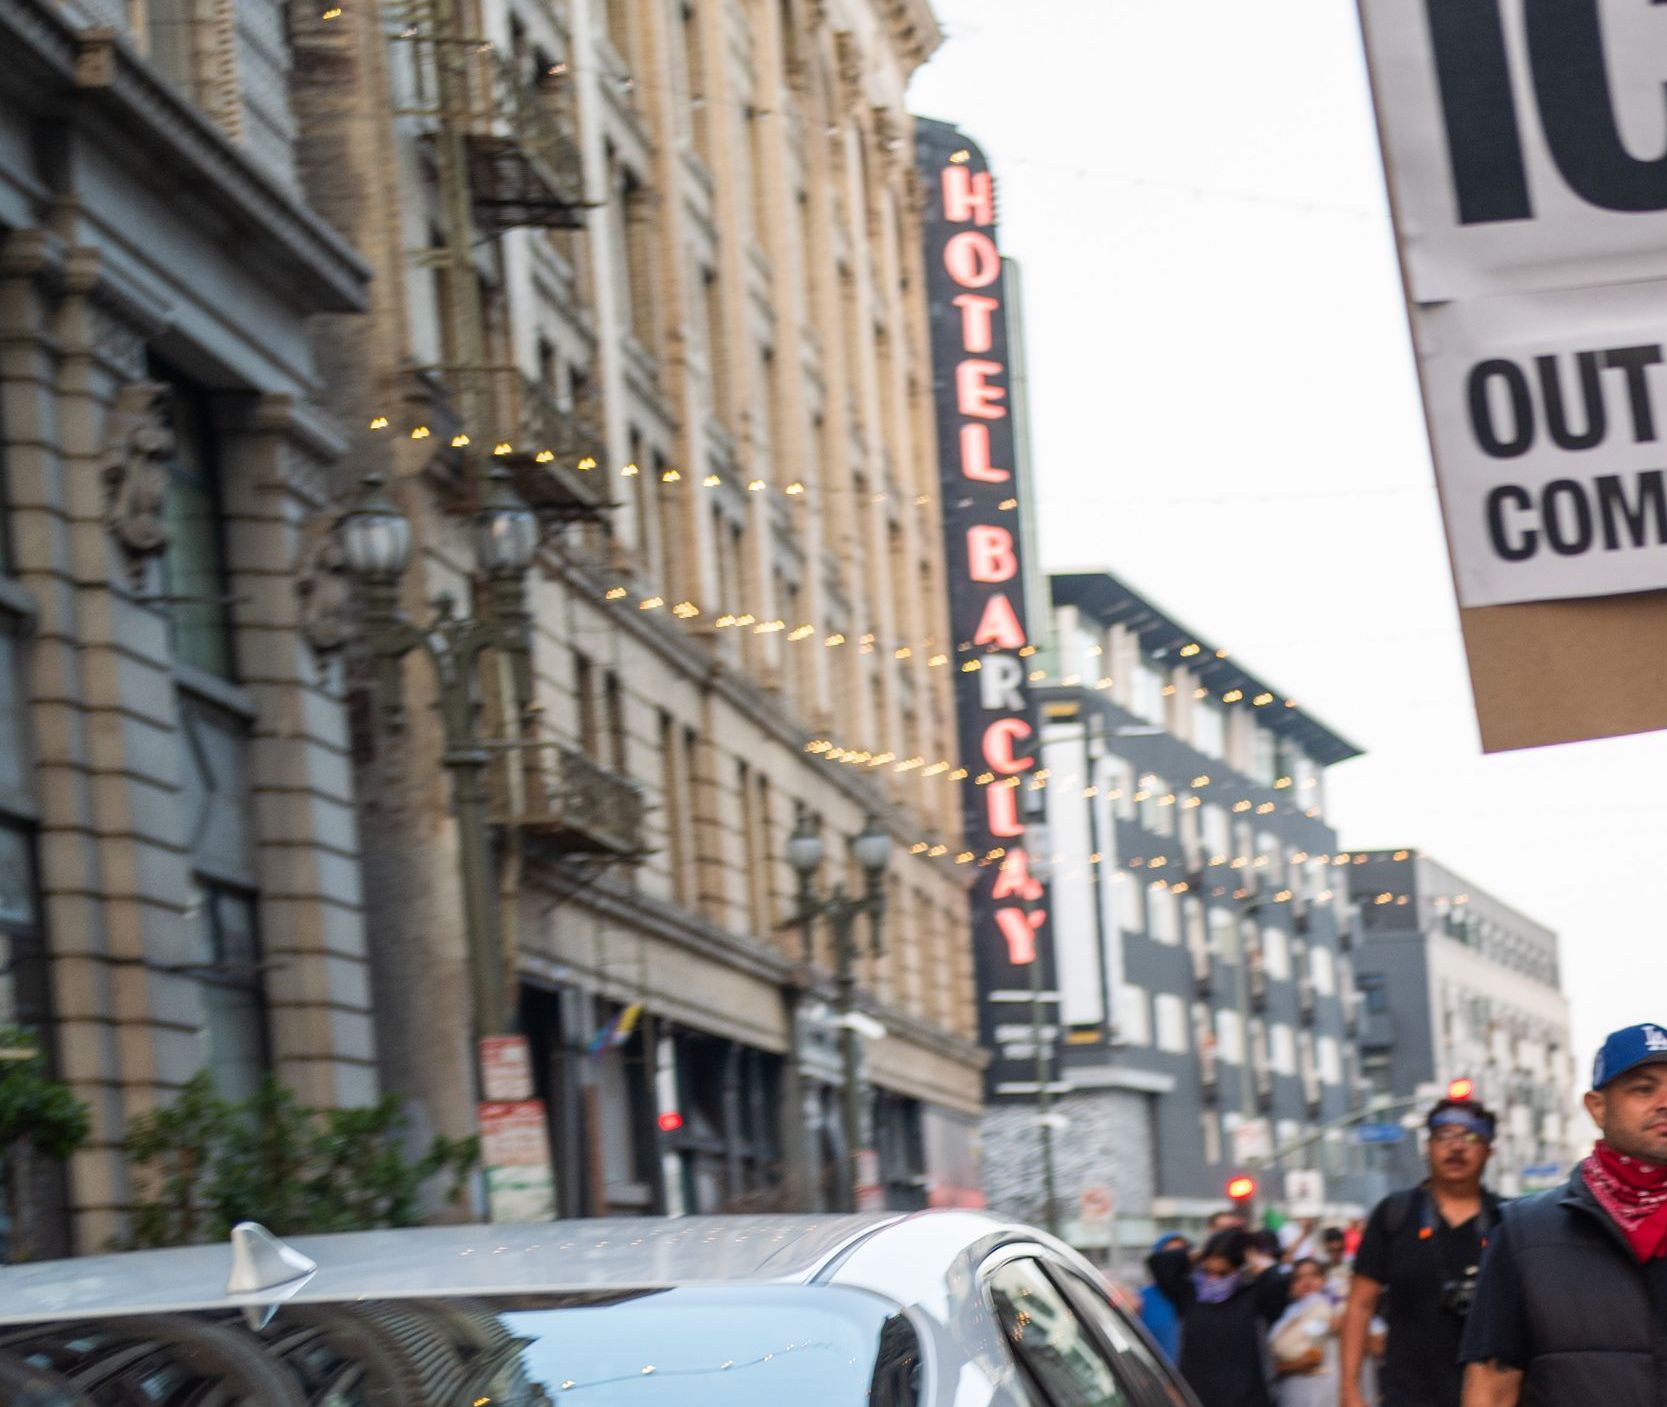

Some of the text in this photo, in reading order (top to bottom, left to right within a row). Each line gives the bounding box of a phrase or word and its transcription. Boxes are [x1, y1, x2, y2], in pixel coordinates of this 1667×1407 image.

[942, 165, 1011, 484] HOTEL
[1466, 343, 1665, 460] OUT
[966, 524, 1046, 965] BARCLAY
